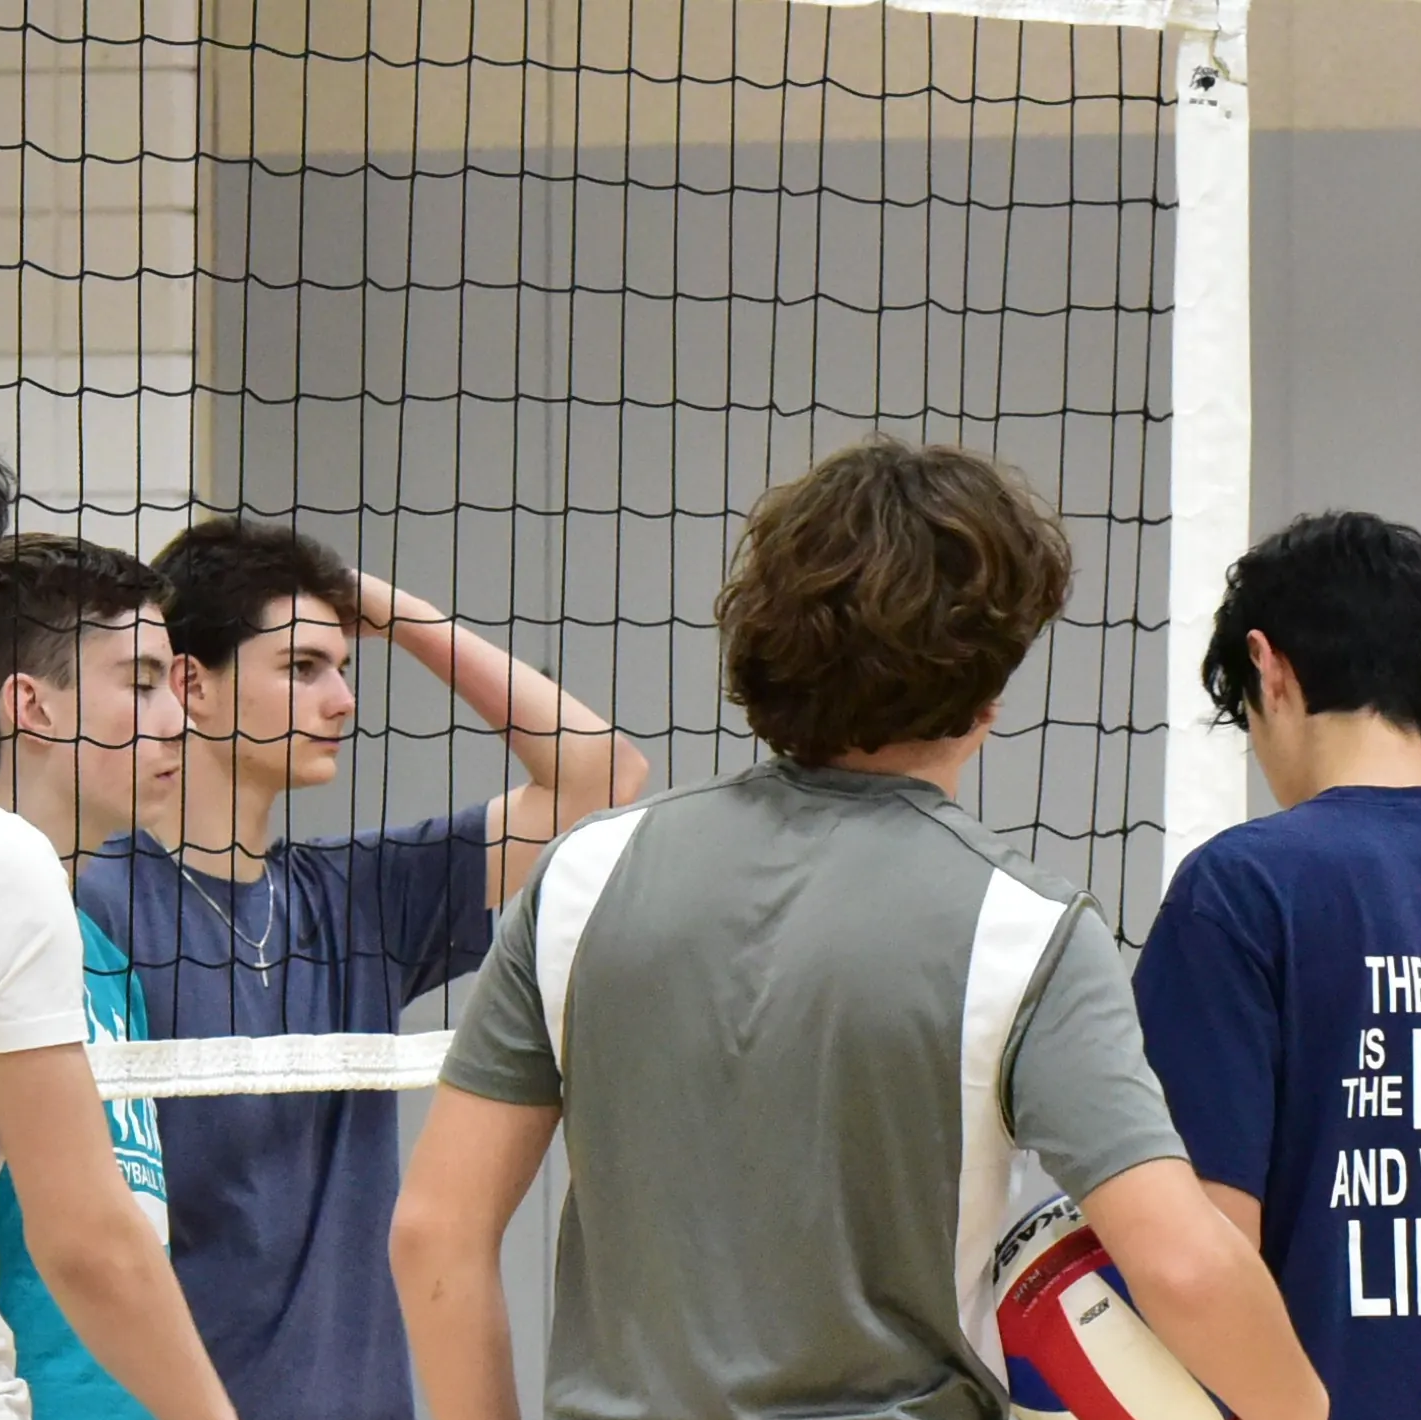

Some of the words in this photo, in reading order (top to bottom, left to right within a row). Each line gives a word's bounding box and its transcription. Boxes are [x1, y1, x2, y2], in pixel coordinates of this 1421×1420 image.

[1358, 1028, 1386, 1070] IS
[1342, 1076, 1403, 1119] THE
[1330, 1148, 1408, 1209] AND
